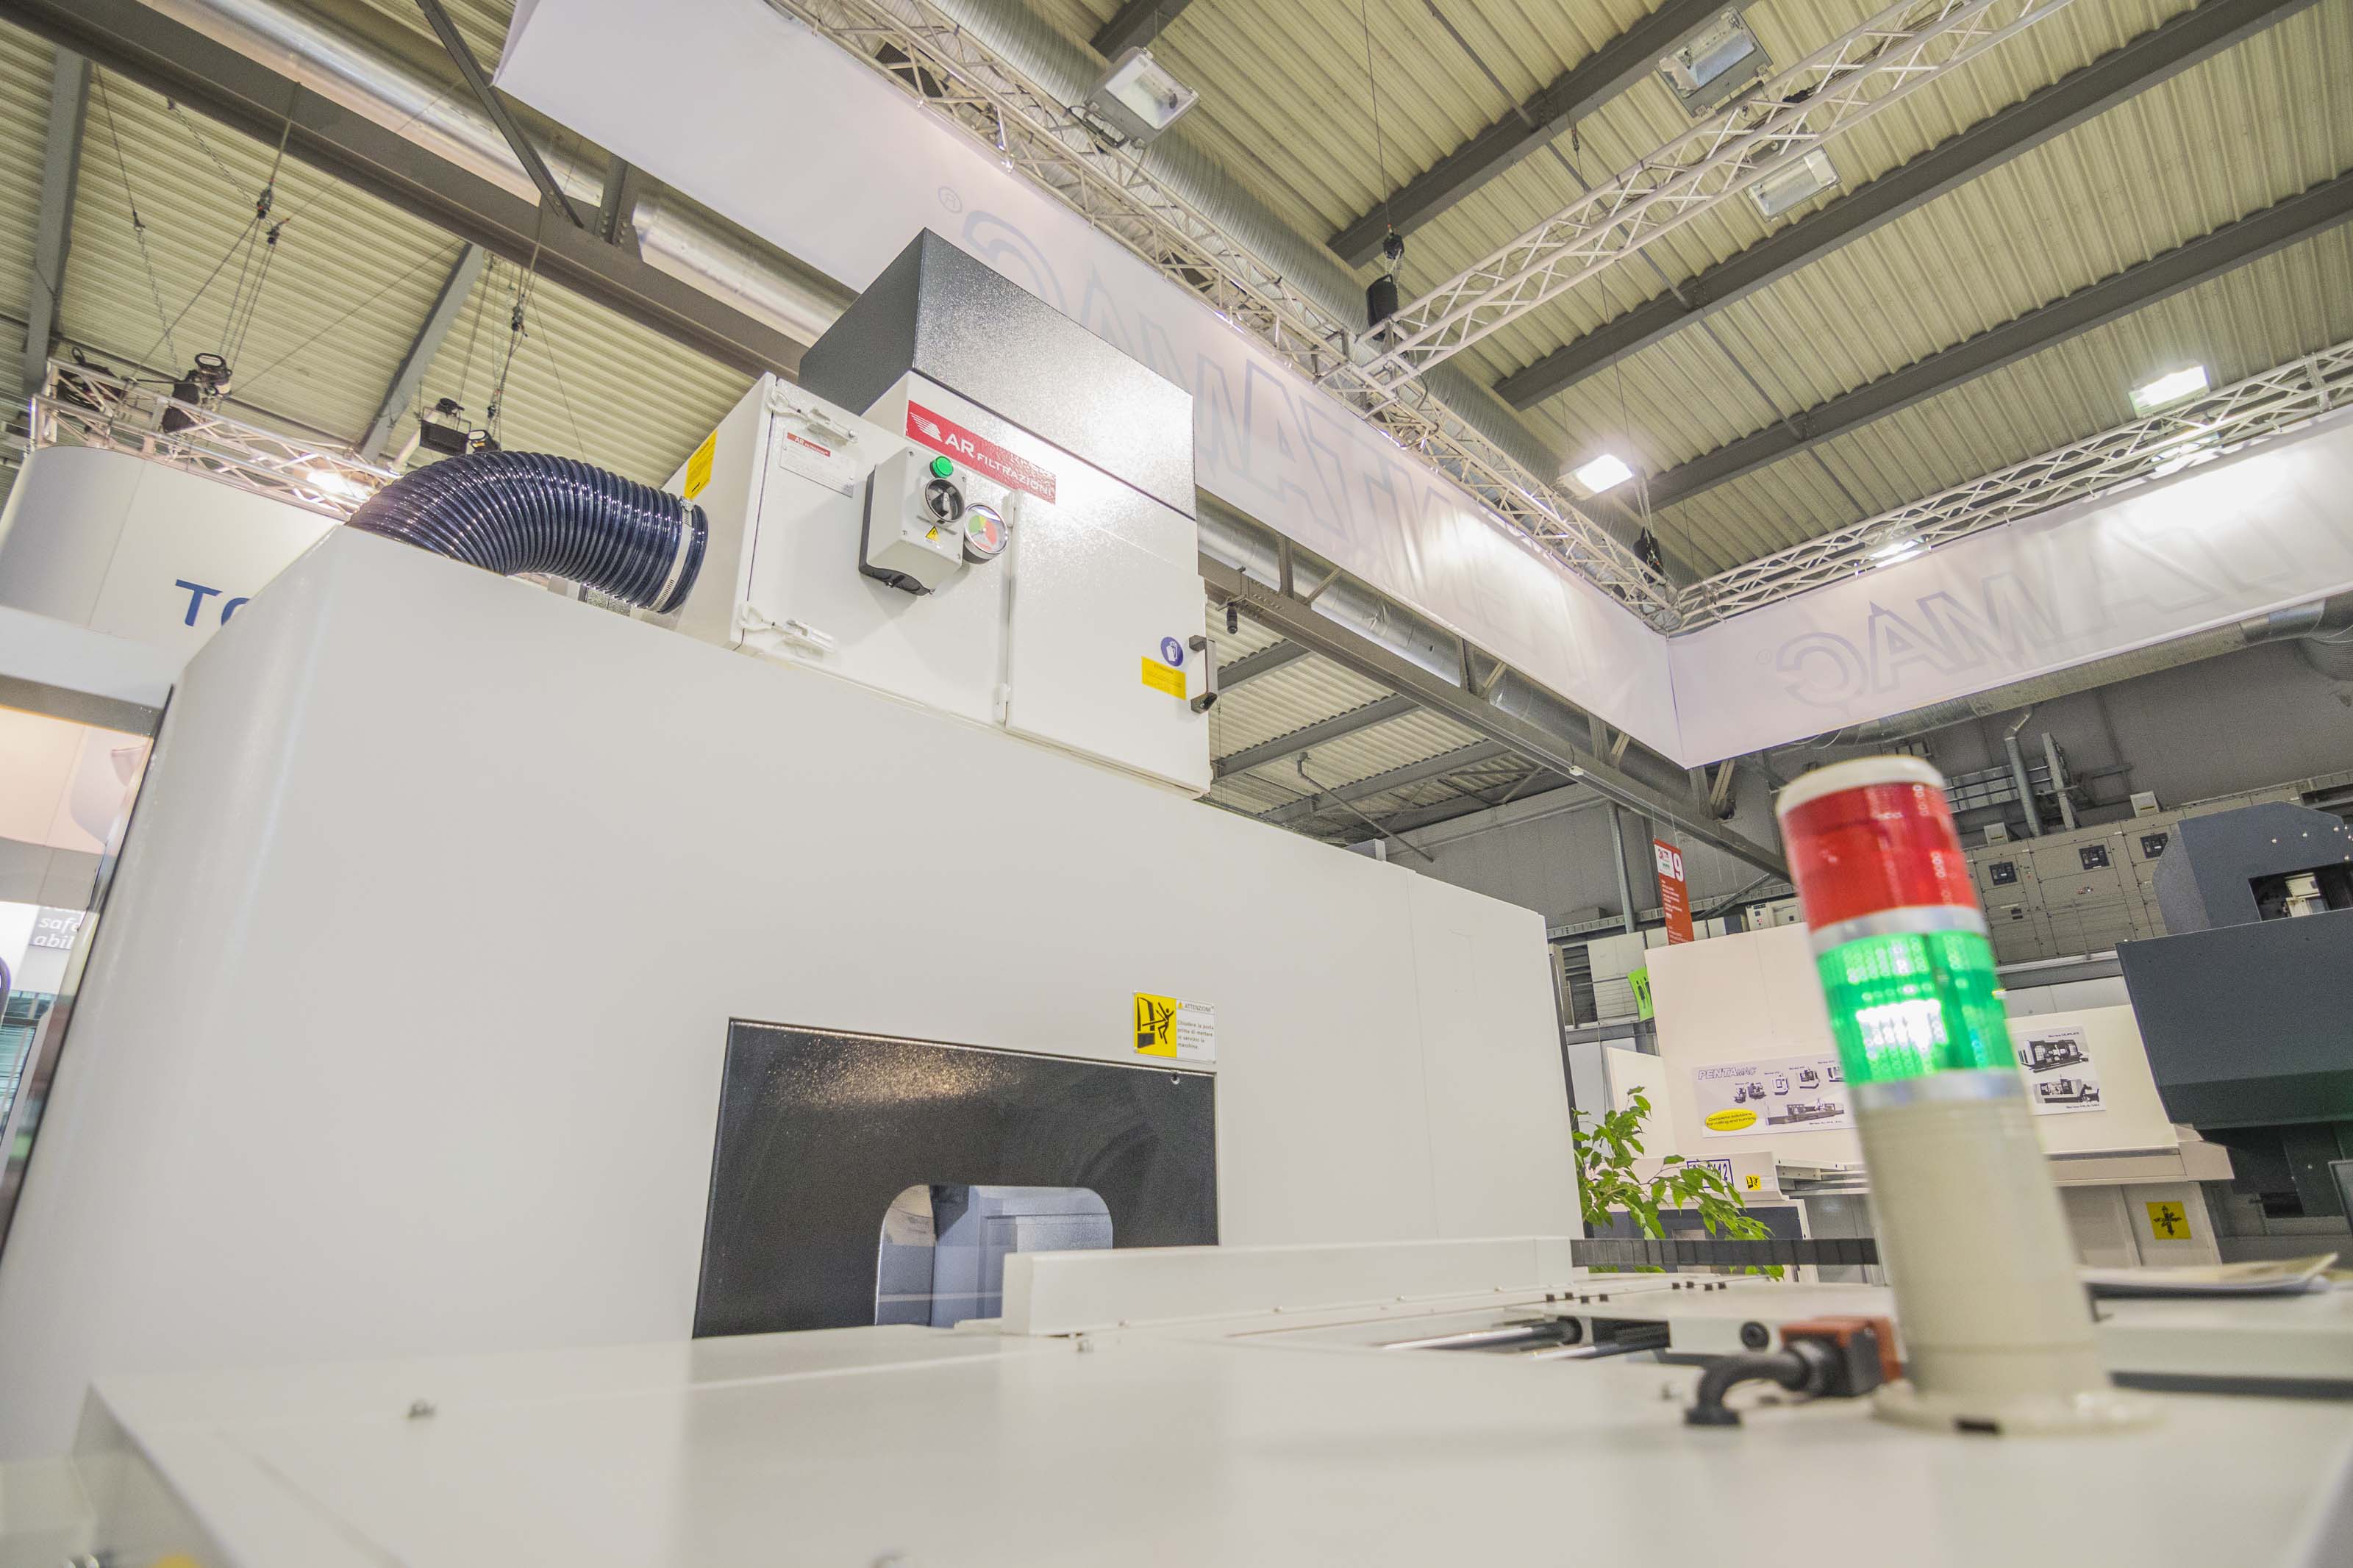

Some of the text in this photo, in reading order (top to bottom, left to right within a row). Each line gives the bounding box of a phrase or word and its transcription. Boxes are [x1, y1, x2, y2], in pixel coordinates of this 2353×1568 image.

[945, 434, 1051, 498] AR FILTRAZIONI
[1673, 852, 1684, 882] 9
